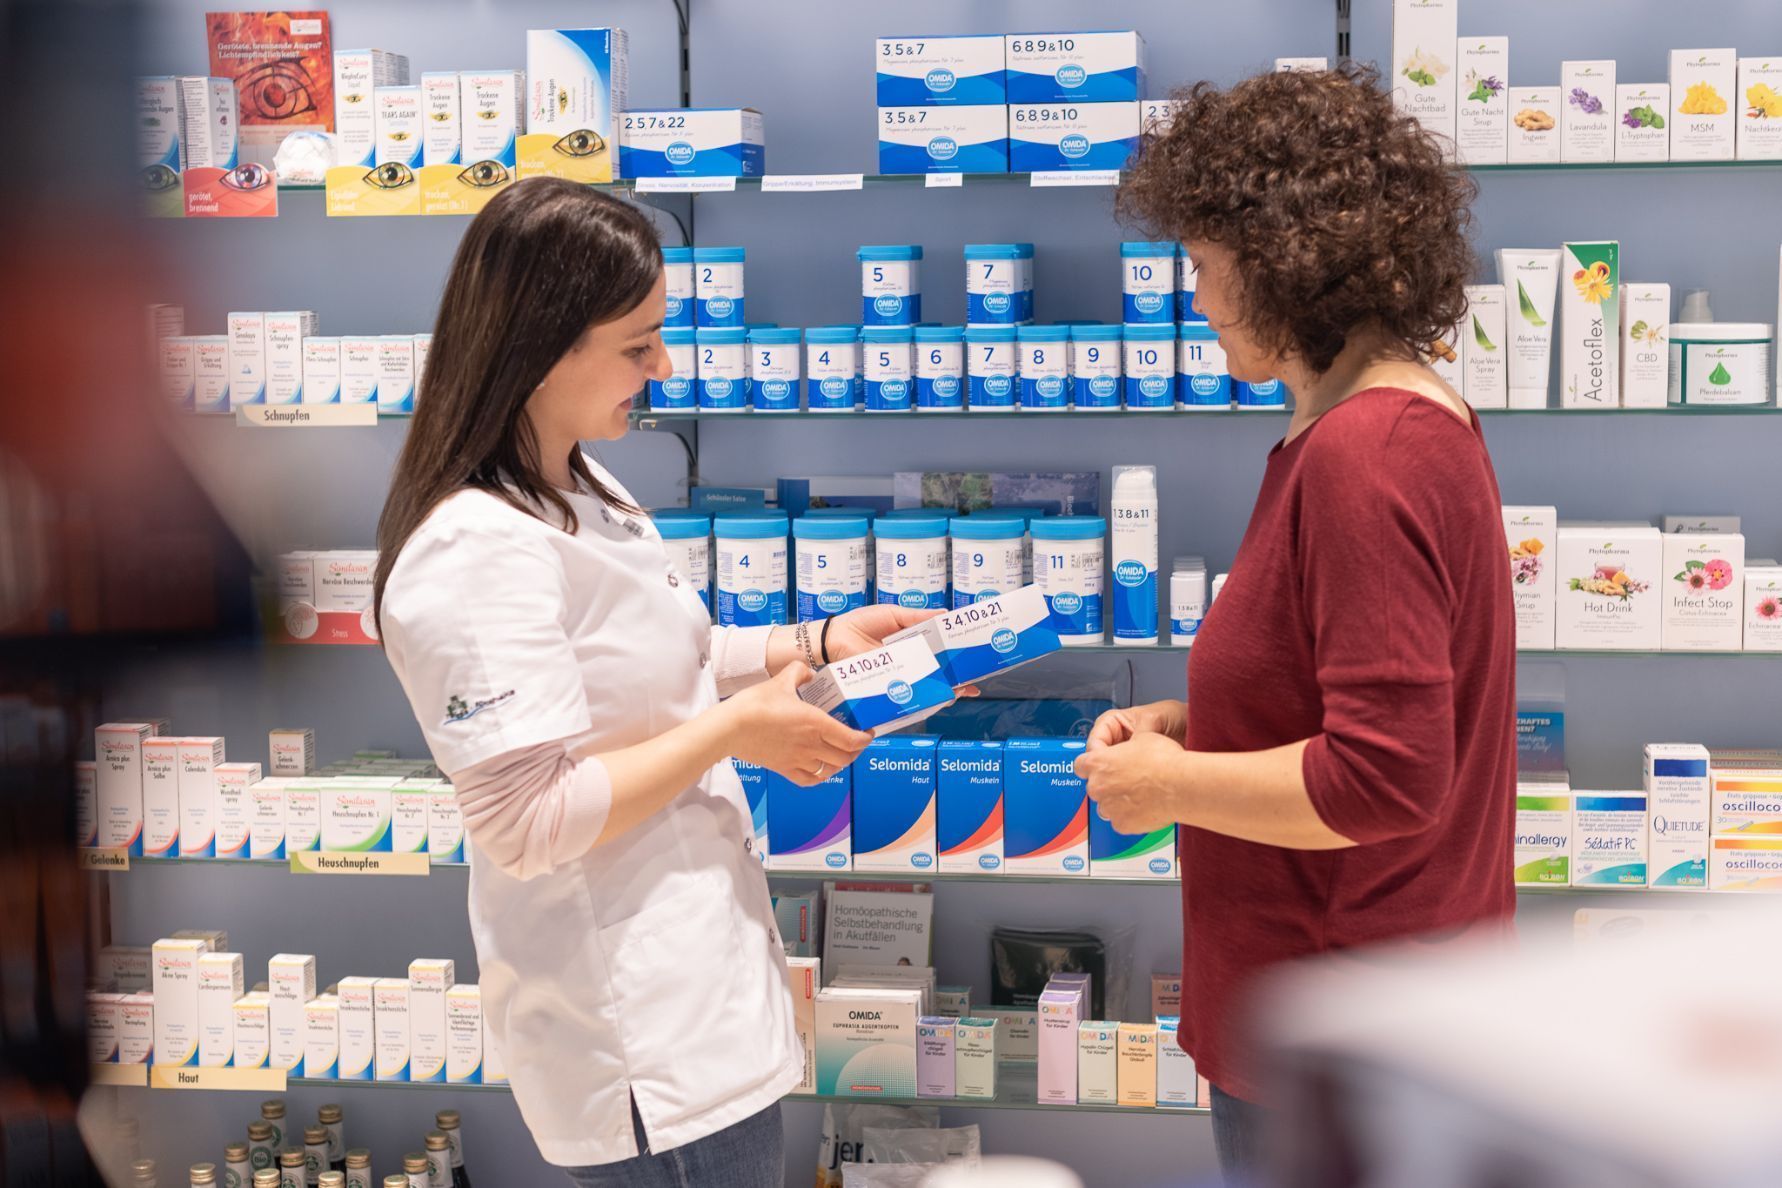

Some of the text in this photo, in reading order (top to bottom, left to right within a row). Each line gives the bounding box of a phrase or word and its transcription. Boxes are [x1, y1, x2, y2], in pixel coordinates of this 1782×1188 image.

[294, 42, 322, 50] Augen?
[218, 50, 299, 59] Lichtempfindlichkeit?
[1058, 69, 1084, 78] OMIDA
[1415, 94, 1436, 103] Gute
[432, 102, 448, 110] Augen
[480, 100, 496, 108] Augen
[1404, 104, 1446, 114] Nachtbad
[382, 111, 396, 119] TEARS
[1462, 108, 1504, 116] Gute Nacht
[1474, 118, 1492, 126] Sirup
[1570, 123, 1607, 132] Lavandula
[1690, 124, 1714, 132] MSM
[1522, 134, 1546, 142] Ingwer
[1622, 131, 1665, 141] L-Tryptophan
[930, 142, 956, 150] OMIDA
[1062, 140, 1086, 148] OMIDA
[703, 268, 712, 282] 2
[873, 268, 883, 282] 5
[984, 264, 994, 280] 7
[1132, 266, 1152, 280] 10
[710, 300, 731, 310] OMIDA
[878, 300, 899, 310] OMIDA
[987, 296, 1008, 306] OMIDA
[1138, 296, 1160, 306] OMIDA
[704, 350, 713, 364] 2
[930, 350, 942, 364] 6
[984, 348, 994, 362] 7
[1034, 350, 1044, 364] 8
[1088, 348, 1099, 362] 9
[1137, 350, 1158, 364] 10
[1189, 346, 1202, 360] 11
[1636, 353, 1658, 362] CBD
[761, 352, 770, 366] 3
[818, 352, 830, 365] 4
[880, 352, 890, 366] 5
[1584, 318, 1602, 402] Acetoflex
[823, 382, 845, 392] OMIDA
[936, 381, 956, 390] OMIDA
[988, 380, 1008, 389] OMIDA
[1040, 381, 1060, 390] OMIDA
[1092, 381, 1114, 390] OMIDA
[1144, 380, 1164, 390] OMIDA
[1194, 379, 1216, 388] OMIDA
[766, 384, 786, 394] OMIDA
[884, 384, 904, 394] OMIDA
[1700, 388, 1742, 396] Pferdebalsam
[264, 408, 310, 422] Schnupfen
[739, 555, 750, 568] 4
[818, 555, 827, 568] 5
[896, 554, 906, 566] 8
[974, 554, 984, 566] 9
[1051, 556, 1064, 568] 11
[330, 562, 368, 574] Similasan
[1118, 566, 1144, 574] OMIDA
[741, 594, 764, 603] OMIDA
[820, 595, 844, 604] OMIDA
[902, 595, 924, 604] OMIDA
[1514, 592, 1540, 600] hymian
[1056, 597, 1078, 606] OMIDA
[1516, 601, 1536, 610] Sirup
[1674, 596, 1733, 610] Infect Stop
[1584, 602, 1632, 613] Hot Drink
[121, 755, 130, 763] plus
[112, 763, 124, 771] Spray
[870, 758, 930, 771] Selomida
[941, 759, 1000, 772] Selomida
[1020, 760, 1075, 774] Selomid
[912, 776, 930, 784] Haut
[970, 776, 1000, 784] Muskeln
[1050, 778, 1082, 786] Muskeln
[332, 810, 367, 819] Heuschnupfen
[1516, 834, 1567, 848] inallergy
[1585, 837, 1638, 850] Sédatif PC
[90, 854, 126, 864] Gelenke
[318, 857, 380, 870] Heuschnupfen
[835, 904, 918, 918] Homöopathische
[834, 917, 924, 933] Selbstbehandlung
[833, 931, 896, 942] in Akutfällen
[174, 972, 188, 980] Spray
[848, 1011, 880, 1020] OMIDA
[178, 1072, 199, 1084] Haut
